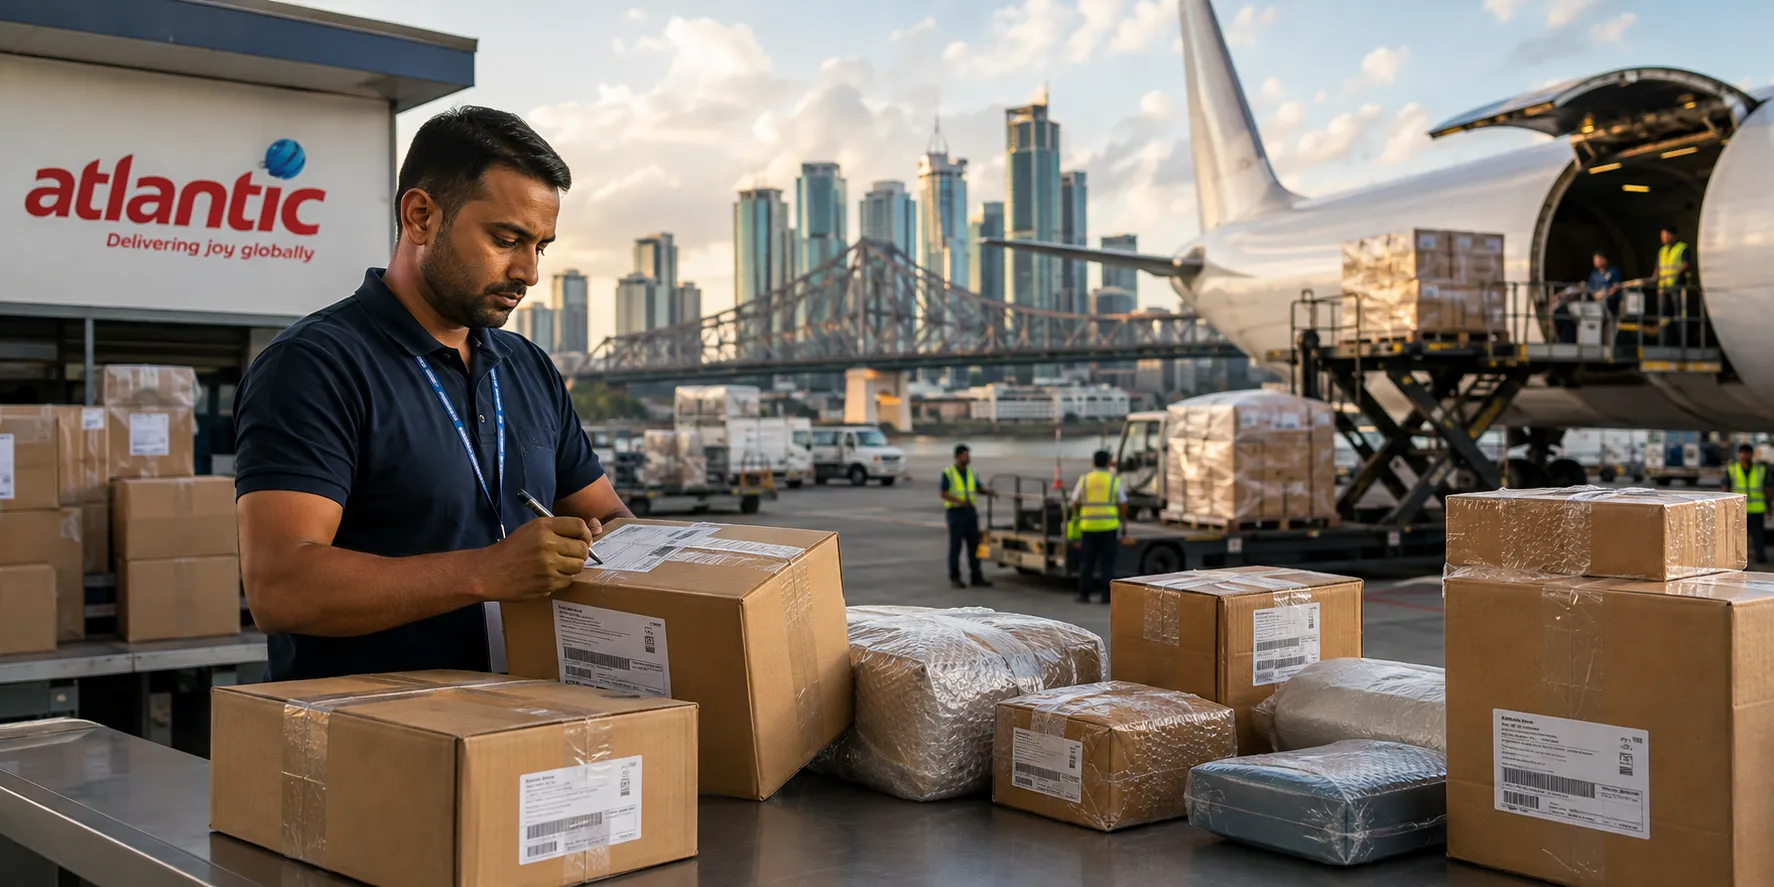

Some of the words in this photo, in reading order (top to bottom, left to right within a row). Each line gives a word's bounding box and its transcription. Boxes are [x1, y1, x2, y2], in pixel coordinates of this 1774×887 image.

[25, 153, 327, 237] atlantic
[106, 232, 200, 256] Delivering
[204, 240, 236, 258] joy
[240, 243, 315, 264] globally
